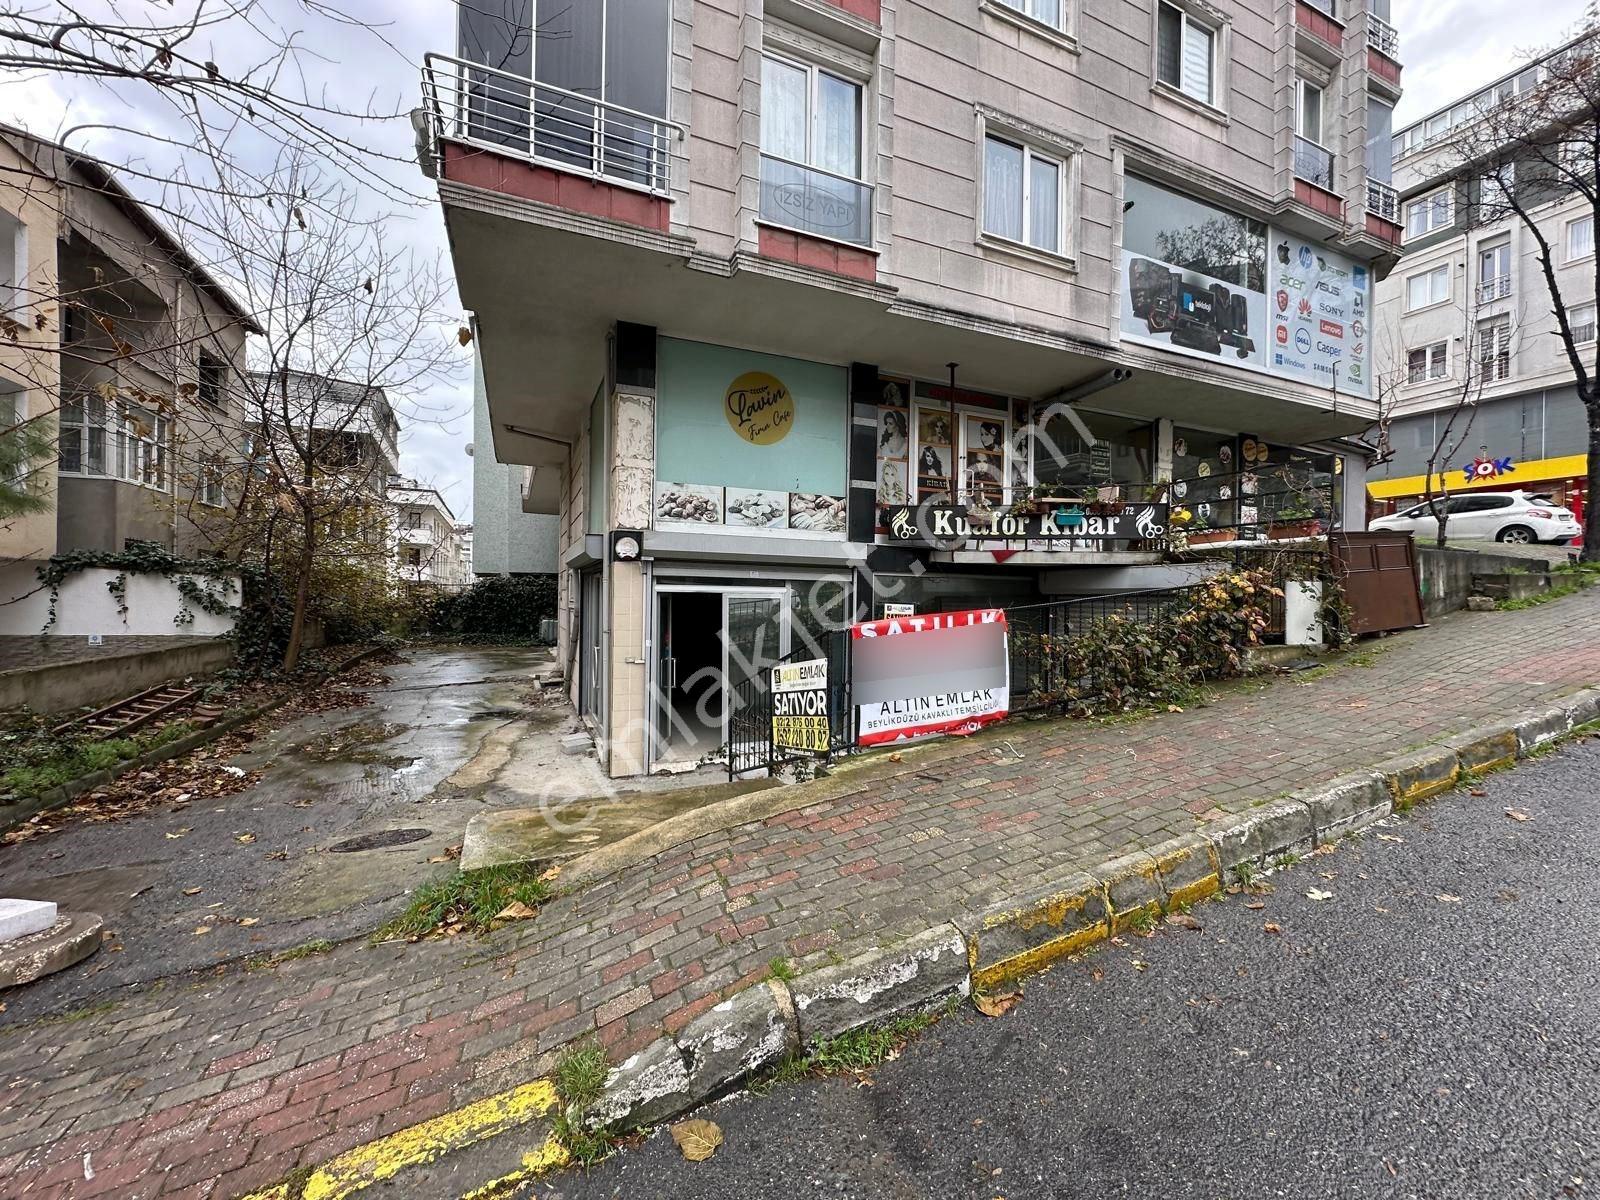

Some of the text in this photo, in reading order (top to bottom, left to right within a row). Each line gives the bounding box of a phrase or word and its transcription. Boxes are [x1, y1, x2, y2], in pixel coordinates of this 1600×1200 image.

[819, 198, 849, 221] YAPI
[1280, 274, 1306, 290] acer
[1315, 280, 1341, 297] ASUS
[1319, 302, 1344, 317] SONY
[1352, 308, 1365, 318] AMD
[1275, 313, 1289, 322] msi
[1321, 322, 1342, 335] Lenovo
[1296, 336, 1310, 346] DELL
[1316, 341, 1341, 357] Casper
[1283, 356, 1306, 370] Windows
[728, 389, 786, 427] Lavin
[1125, 507, 1135, 515] 72
[774, 690, 828, 716] SATIYOR
[776, 717, 791, 728] 0212
[804, 718, 815, 728] 00
[816, 717, 827, 729] 40
[867, 713, 919, 729] BEYLİKDÜZÜ
[922, 710, 953, 721] KAVAKLI
[805, 730, 816, 749] 80
